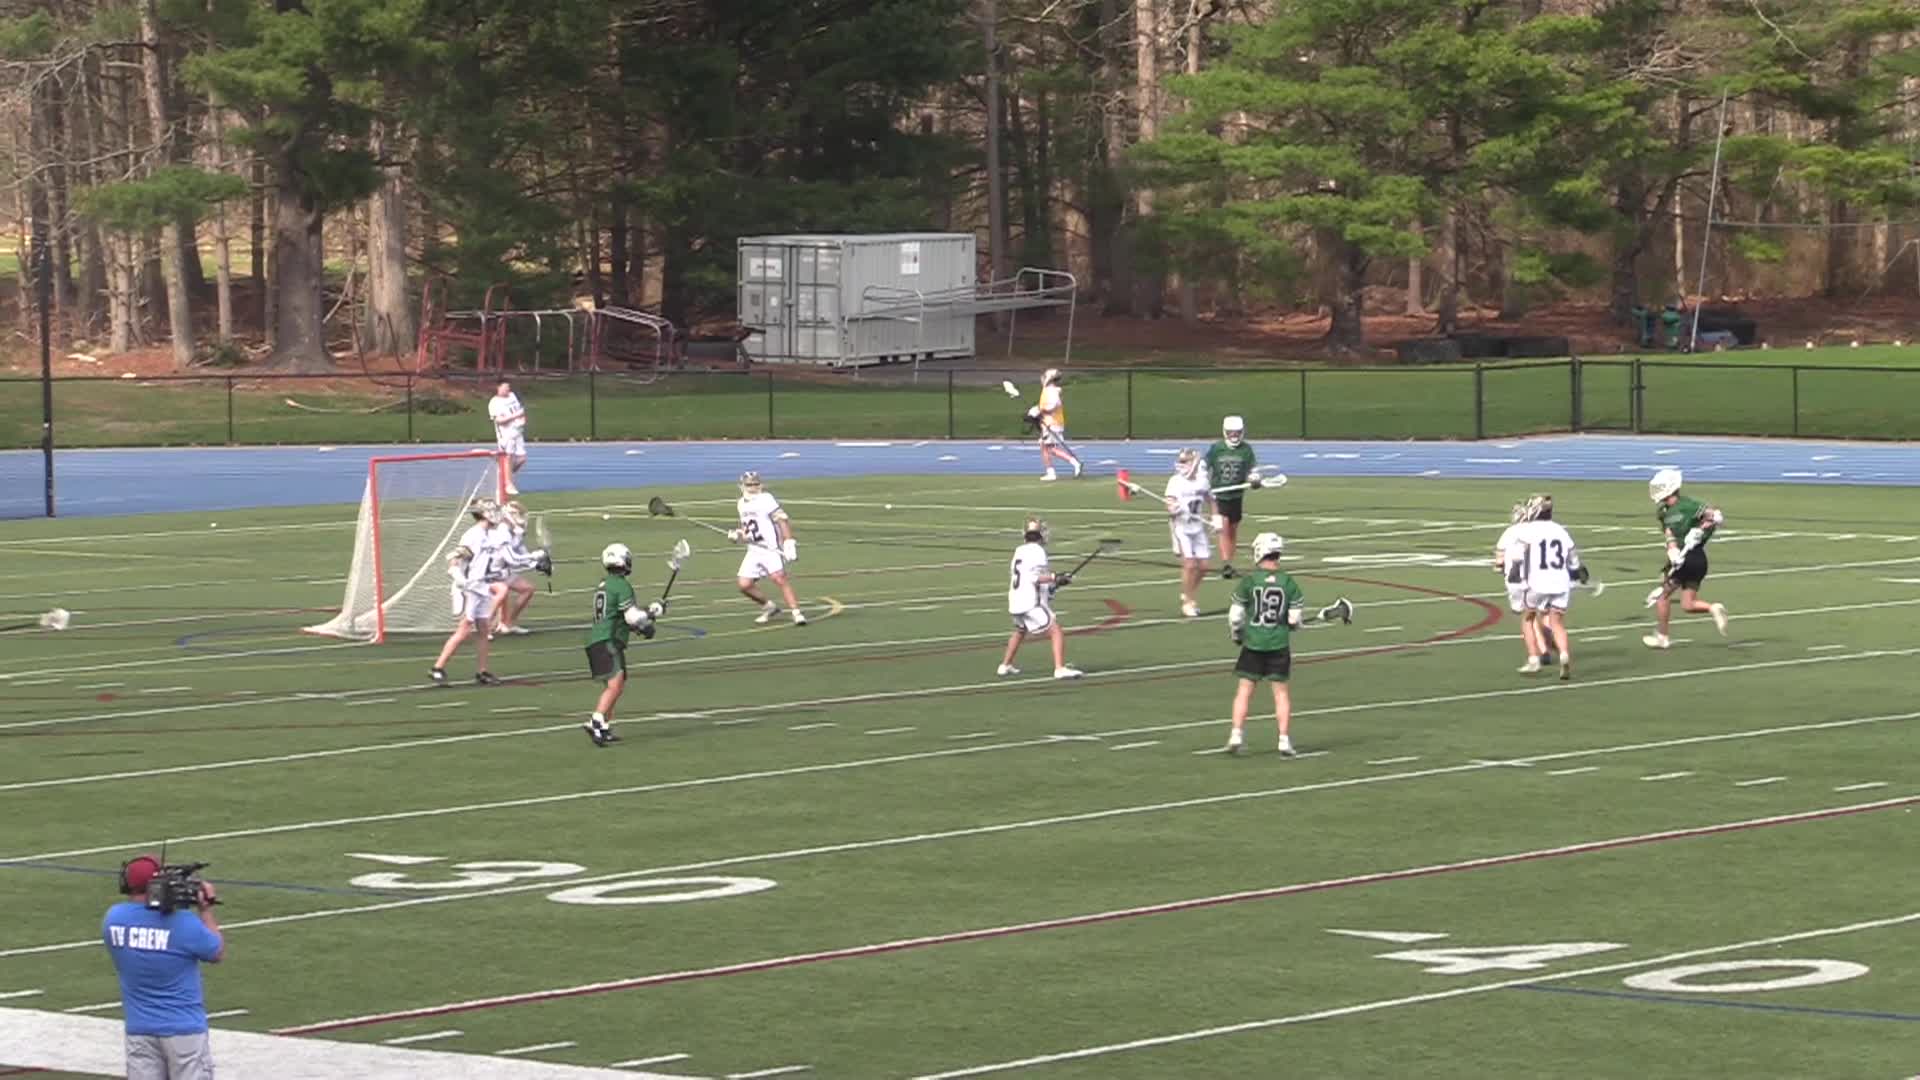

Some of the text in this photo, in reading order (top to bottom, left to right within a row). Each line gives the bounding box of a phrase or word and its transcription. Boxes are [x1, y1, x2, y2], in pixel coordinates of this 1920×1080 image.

[1539, 538, 1565, 571] 13
[1012, 559, 1023, 590] 5
[110, 925, 171, 950] TV CREW
